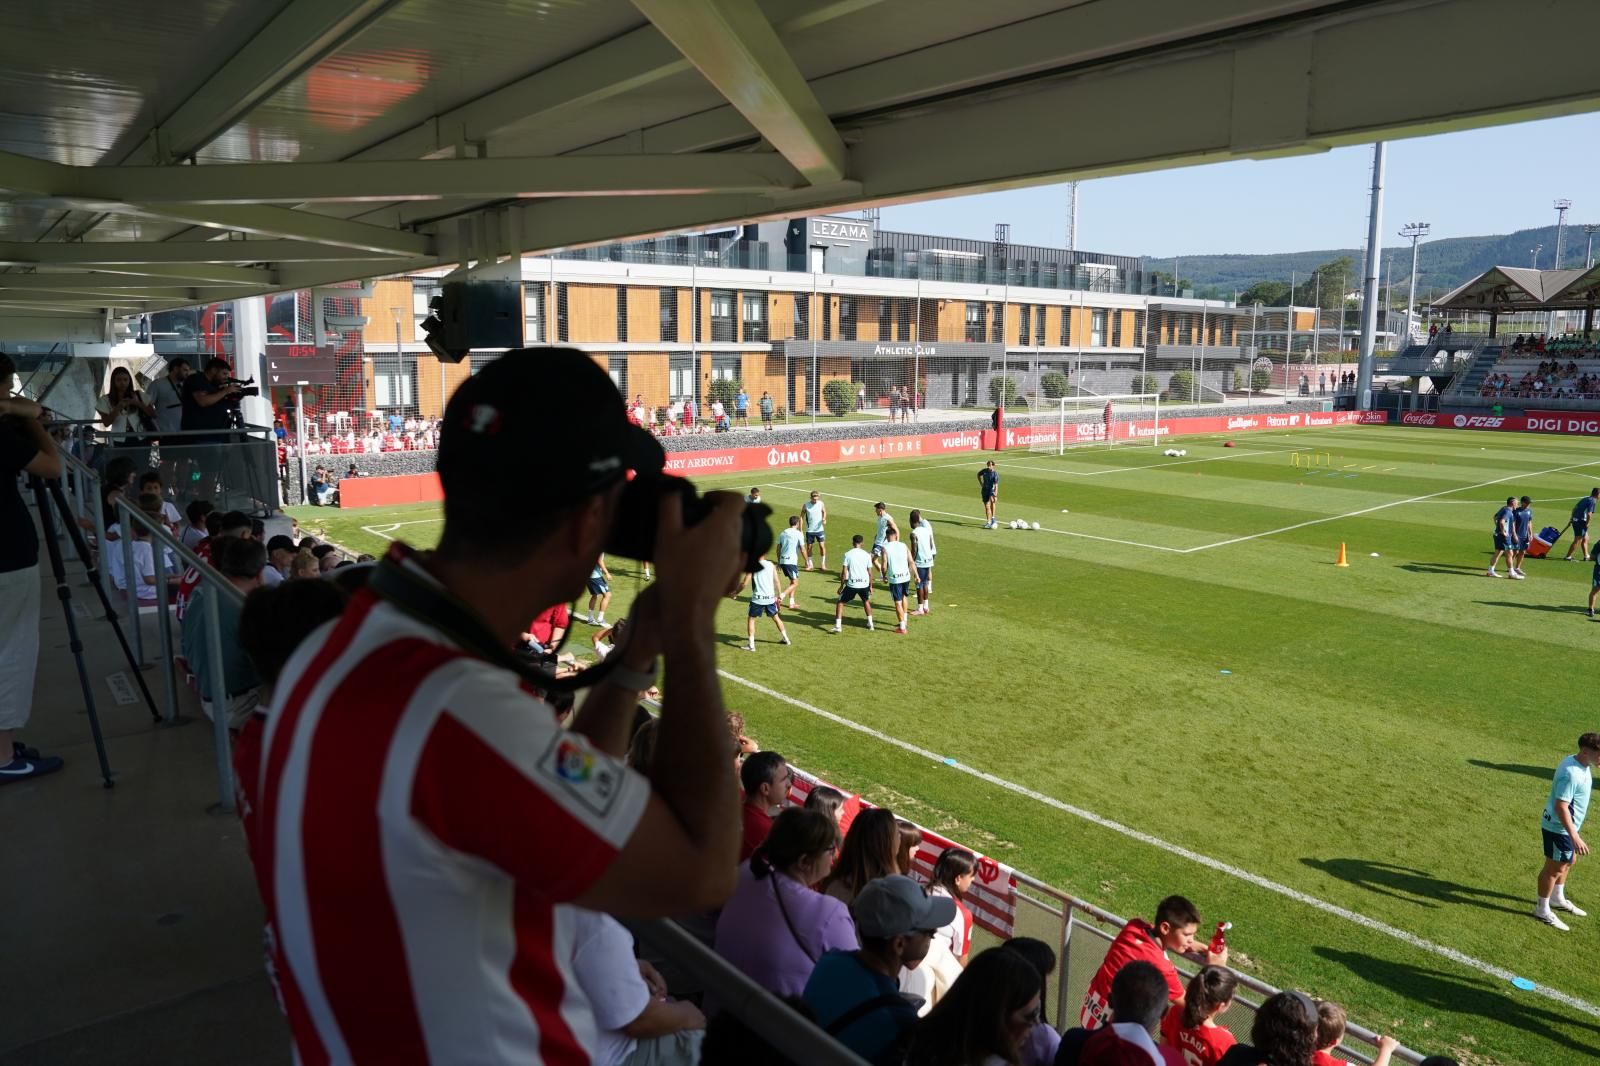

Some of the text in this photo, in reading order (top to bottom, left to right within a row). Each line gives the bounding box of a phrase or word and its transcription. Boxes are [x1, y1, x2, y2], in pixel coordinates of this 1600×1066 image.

[813, 222, 868, 238] LEZAMA
[288, 345, 317, 357] 10:54
[874, 344, 912, 355] ATHLETIC
[271, 361, 278, 369] L
[1366, 411, 1381, 420] Skin
[1137, 425, 1169, 436] kutxaank
[1527, 418, 1600, 433] DIGI DIG
[942, 432, 980, 449] vueling
[1017, 432, 1057, 445] kutxabank
[663, 455, 735, 470] NRY ARROWAY
[780, 449, 811, 464] IMQ
